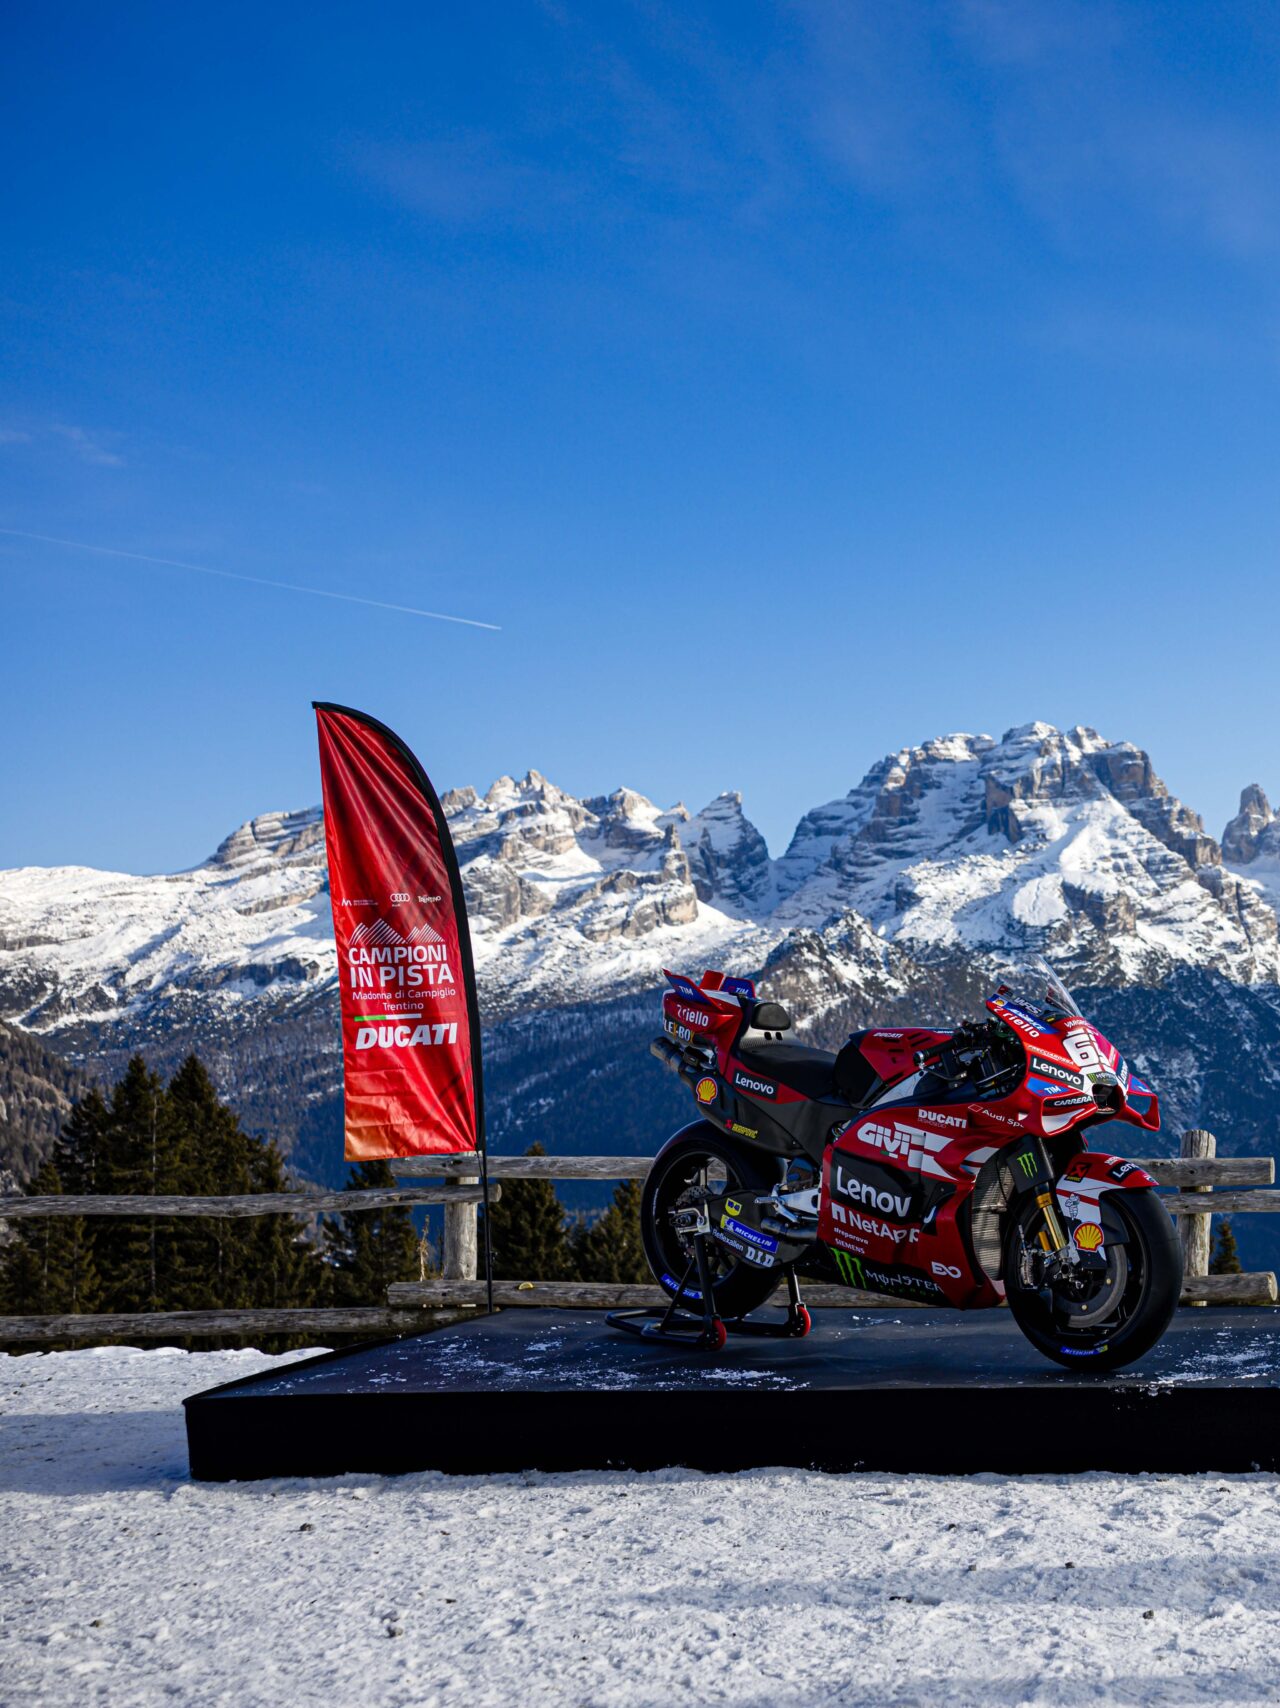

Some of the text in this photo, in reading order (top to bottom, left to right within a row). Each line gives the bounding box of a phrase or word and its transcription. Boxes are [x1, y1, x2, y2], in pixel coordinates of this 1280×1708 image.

[348, 944, 447, 965] CAMPIONI
[351, 963, 454, 988] IN PISTA
[352, 987, 455, 1000] Madonna di Campiglio
[679, 986, 693, 995] TIM
[383, 1001, 424, 1011] Trentino
[1002, 1012, 1040, 1038] riello
[355, 1022, 457, 1050] DUCATI
[1033, 1058, 1081, 1085] Lenovo
[735, 1073, 774, 1095] Lenovo
[1044, 1084, 1062, 1094] TIM
[1053, 1095, 1093, 1106] CARRERA
[918, 1108, 967, 1129] DUCATI
[981, 1109, 1006, 1122] Audi
[857, 1122, 911, 1155] GIVI
[735, 1227, 773, 1246] MICHELIN
[848, 1210, 920, 1244] NetApp
[835, 1238, 865, 1254] SIEMENS
